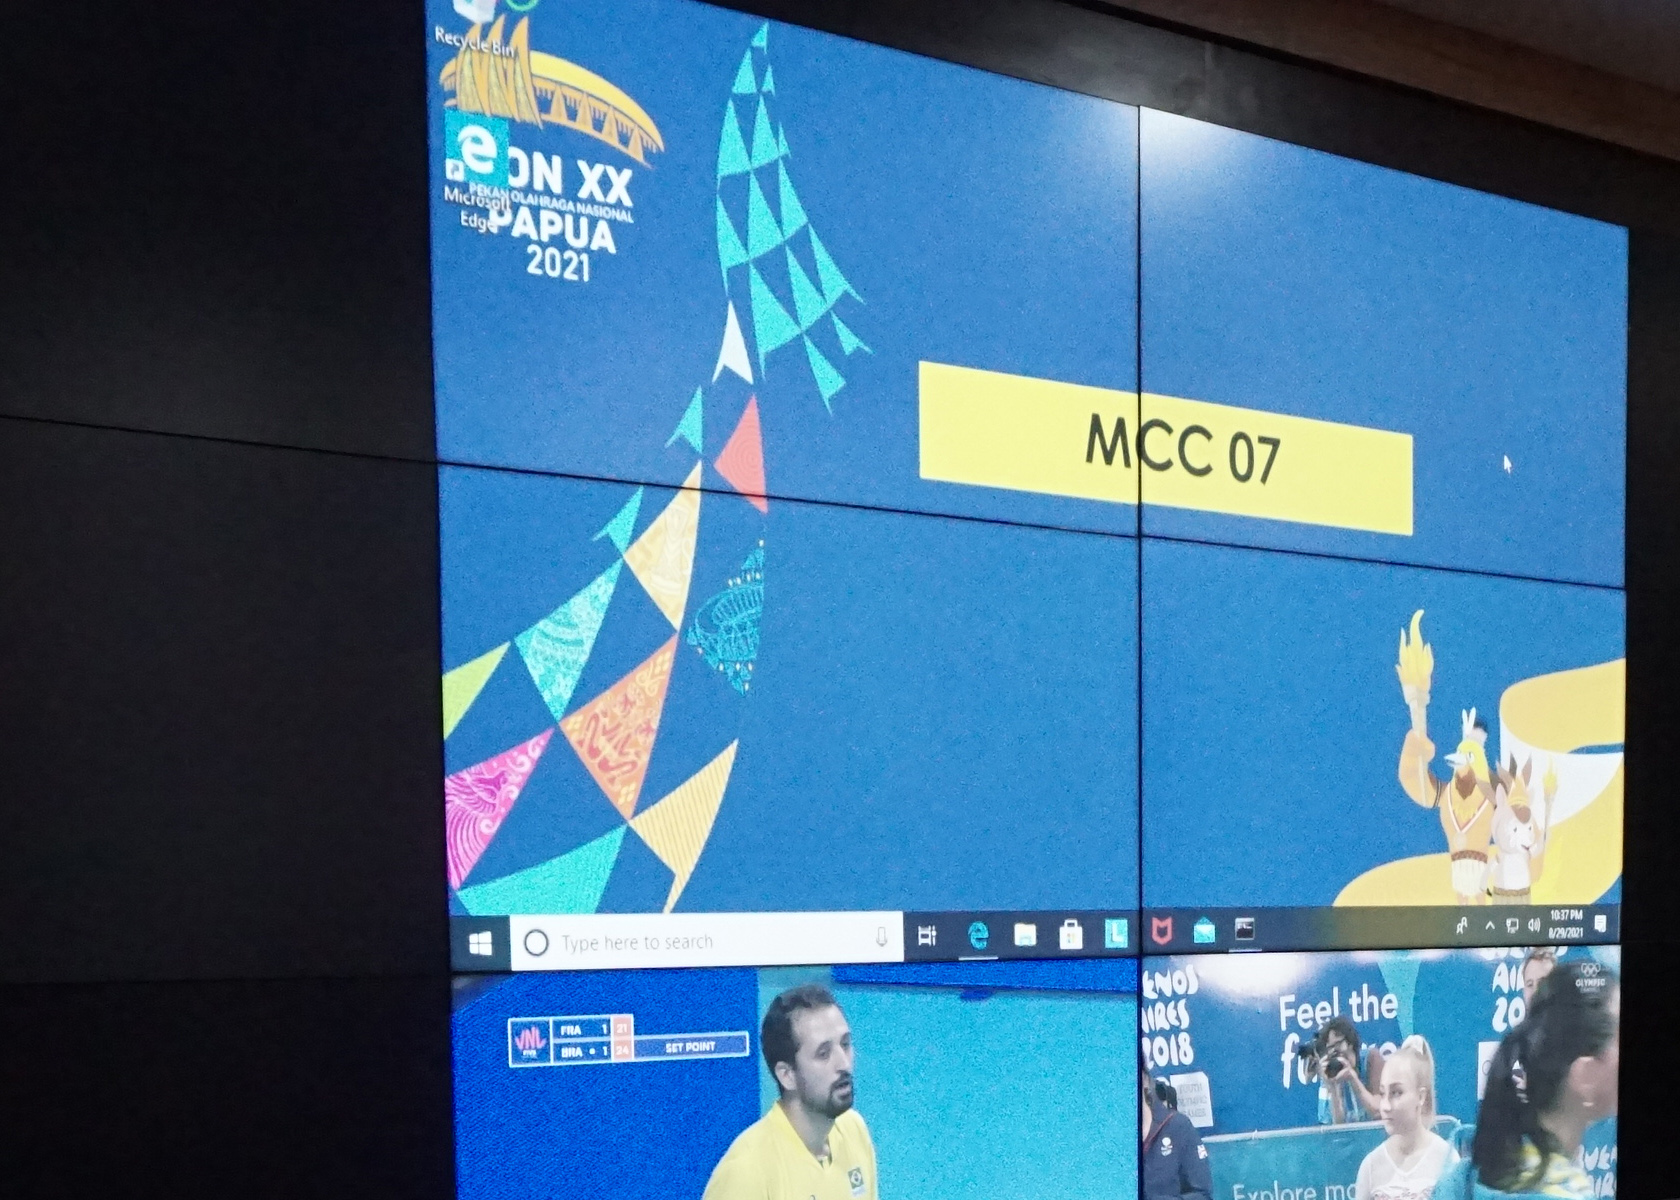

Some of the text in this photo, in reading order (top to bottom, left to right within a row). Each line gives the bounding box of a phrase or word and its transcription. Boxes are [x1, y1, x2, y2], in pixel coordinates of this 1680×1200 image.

[435, 26, 515, 58] Recycle Bin
[507, 146, 634, 207] ON XX
[444, 186, 511, 211] Microsoft
[469, 183, 634, 223] PEKAN OLAHRAGA NASIONAL
[460, 210, 494, 234] Edge
[489, 205, 617, 254] PAPUA
[527, 244, 590, 282] 2021
[1085, 412, 1282, 486] MCC 07
[562, 931, 713, 954] Type here to search
[1142, 964, 1199, 999] ENOS
[1279, 983, 1399, 1031] Feel the
[665, 1043, 684, 1054] SET
[686, 1041, 716, 1053] POINT
